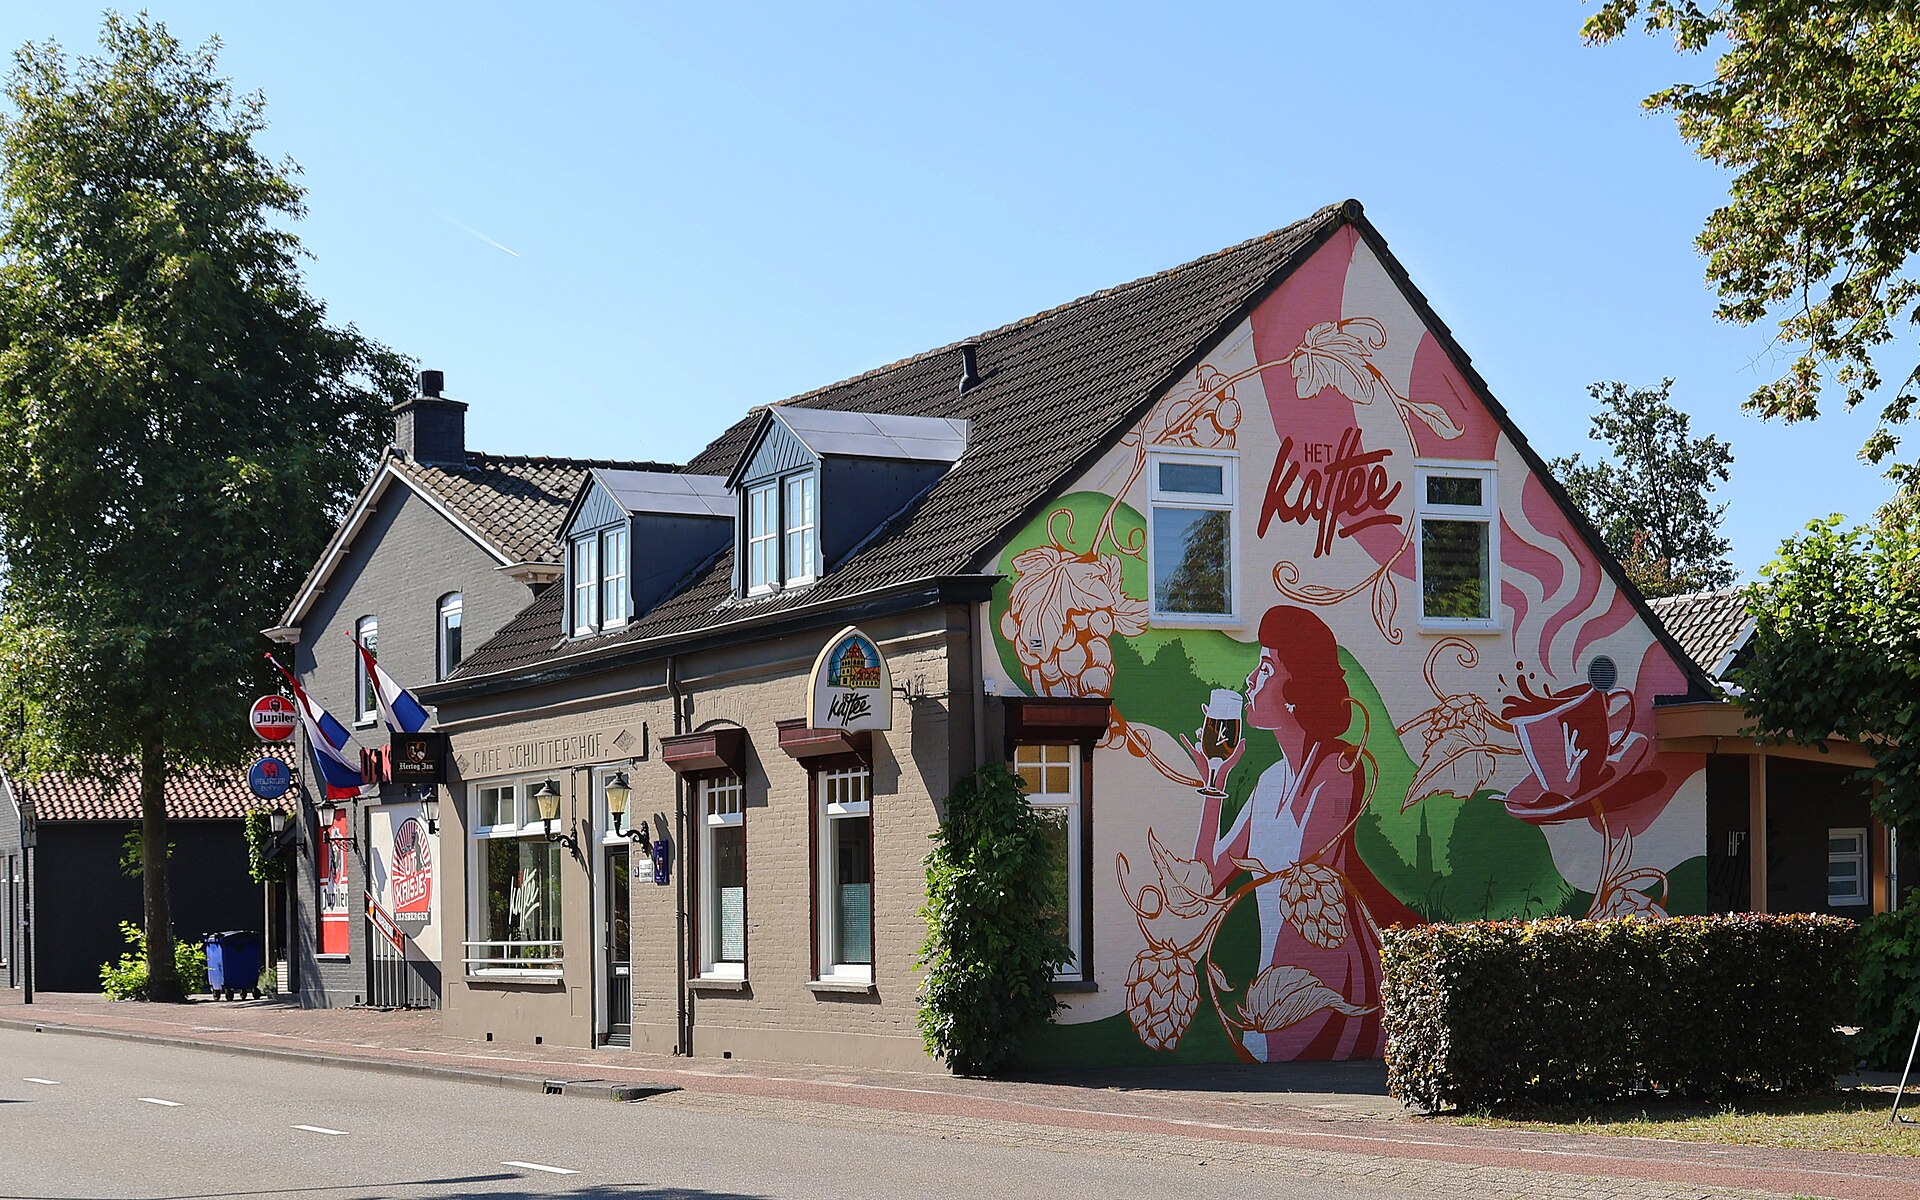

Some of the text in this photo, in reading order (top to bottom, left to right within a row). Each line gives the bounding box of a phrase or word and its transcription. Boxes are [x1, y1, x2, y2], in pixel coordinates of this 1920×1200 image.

[1304, 443, 1333, 463] HET
[256, 712, 295, 725] Jupiler
[398, 762, 434, 772] Hertog Jan
[322, 888, 349, 911] Jupiler
